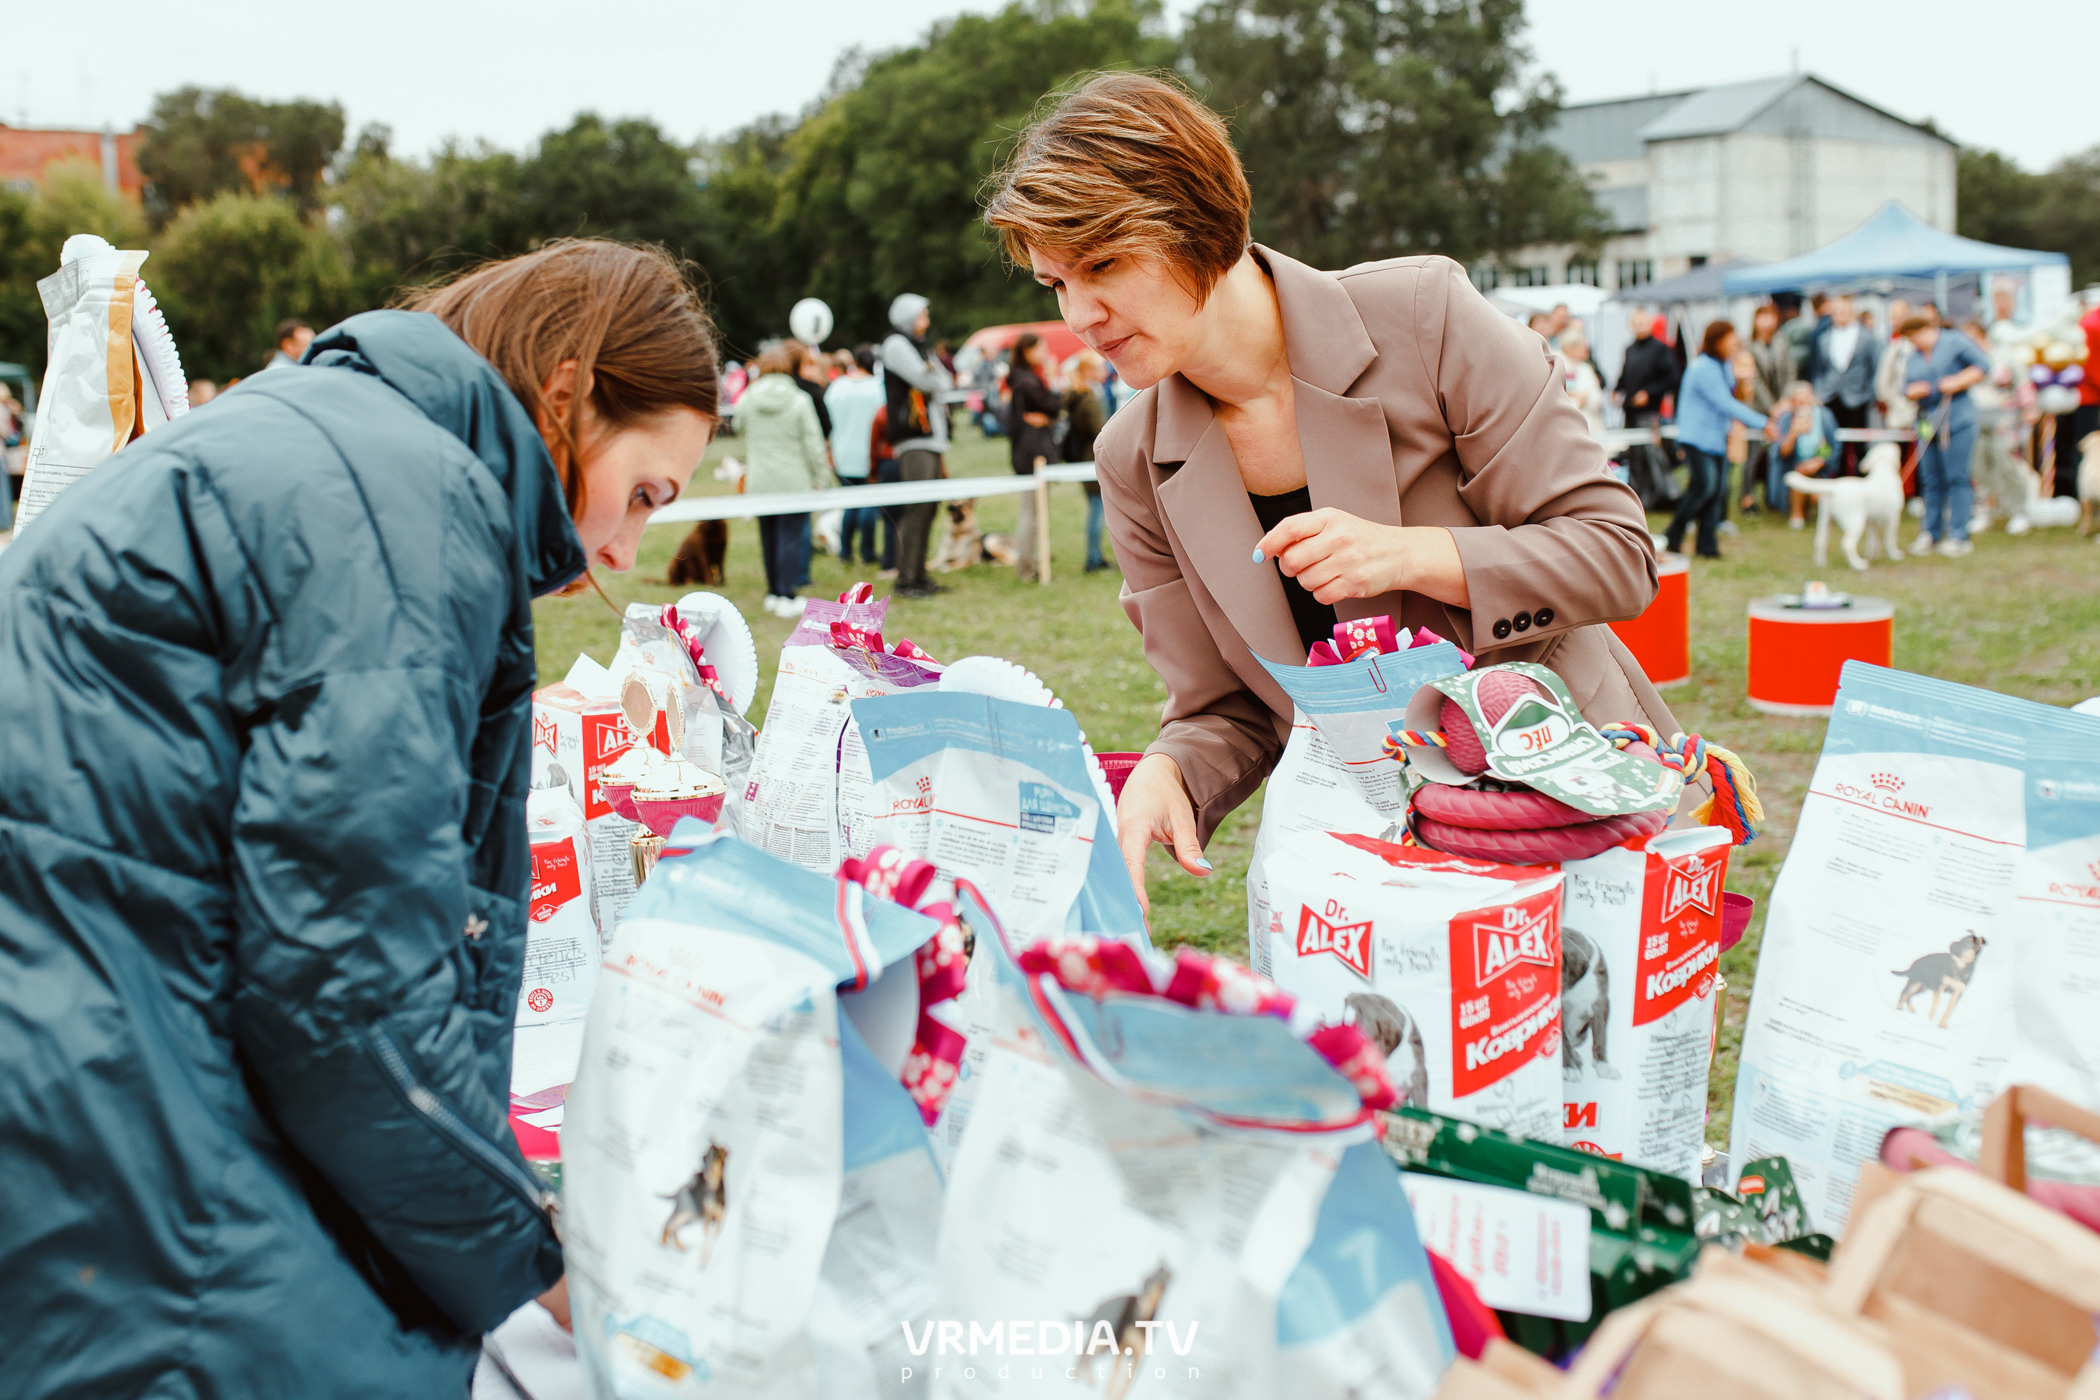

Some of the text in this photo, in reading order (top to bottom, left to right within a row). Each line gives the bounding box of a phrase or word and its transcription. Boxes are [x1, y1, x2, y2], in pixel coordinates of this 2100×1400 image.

[535, 720, 556, 750] ALEX
[603, 729, 641, 753] ALE
[893, 797, 929, 811] ROYAL
[1834, 782, 1930, 819] ROYAL CANIN
[1668, 869, 1714, 913] ALEX
[1325, 898, 1349, 921] Dr.
[1502, 906, 1533, 930] Dr.
[1300, 913, 1368, 971] ALEX
[1484, 917, 1550, 976] ALEX
